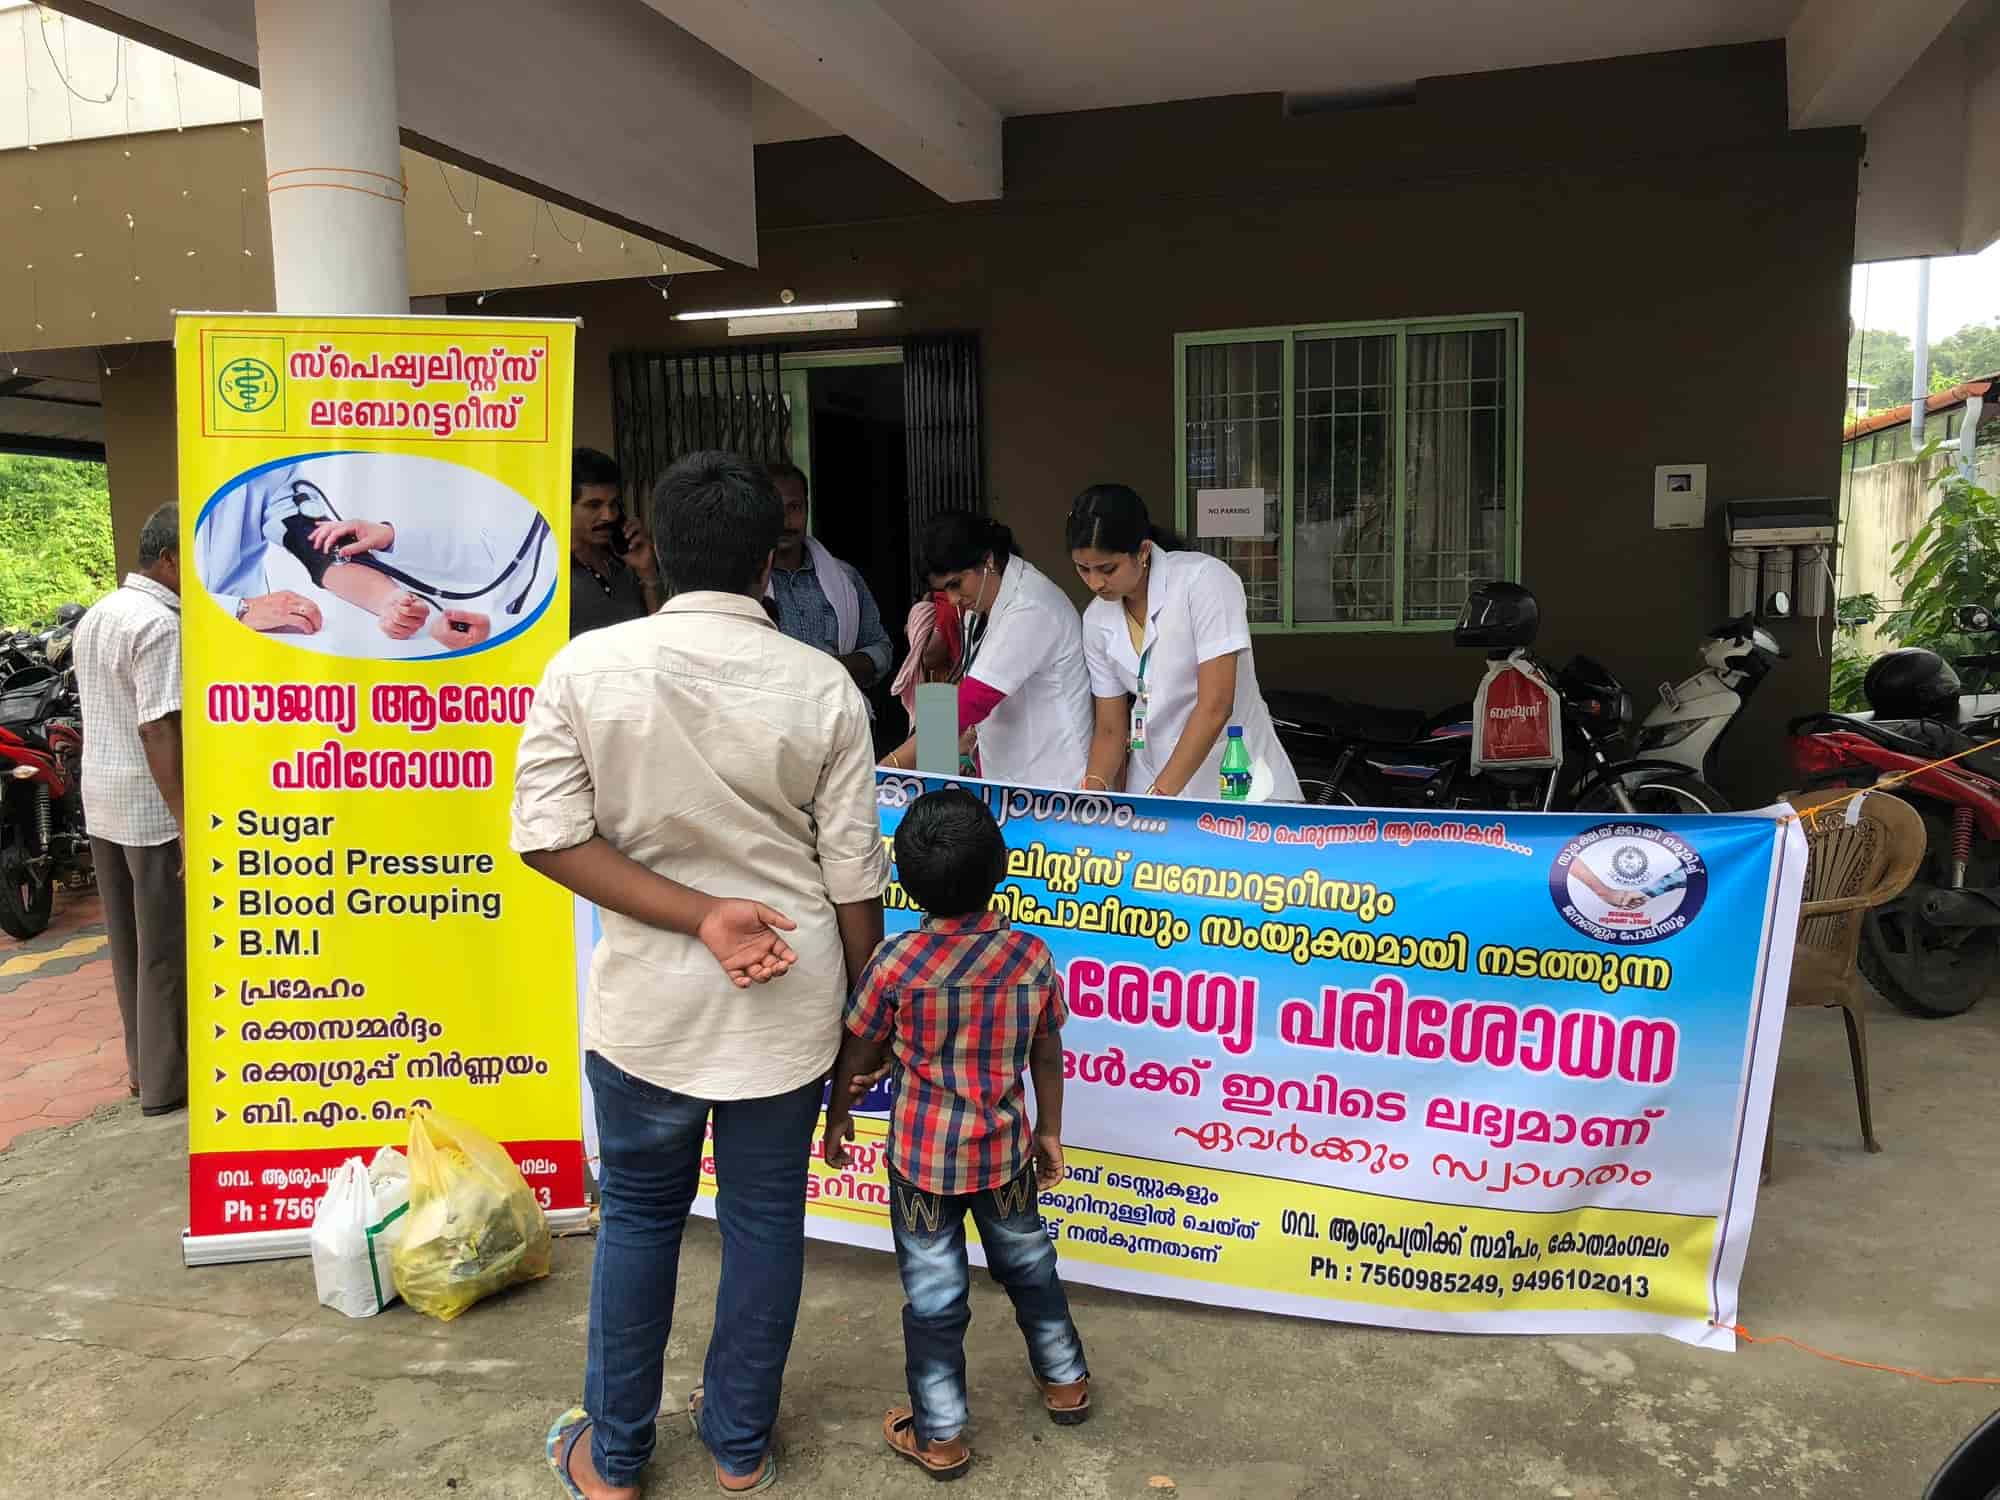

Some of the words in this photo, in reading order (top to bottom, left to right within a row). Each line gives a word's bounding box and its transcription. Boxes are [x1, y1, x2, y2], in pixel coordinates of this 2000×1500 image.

[310, 396, 524, 436] ലബോറട്ടറീസ്
[372, 684, 535, 731] ആരോഗ
[272, 741, 493, 789] പരിശോധന
[237, 809, 335, 842] Sugar
[1199, 813, 1245, 839] കന്നി
[1249, 822, 1271, 842] 20
[1275, 818, 1378, 848] പെരുന്നാൾ
[238, 849, 334, 876] Blood
[346, 848, 494, 876] Pressure
[238, 889, 335, 916] Blood
[346, 887, 502, 920] Grouping
[1132, 860, 1396, 922] ലബോറട്ടറീസും
[239, 929, 320, 956] B.M.I
[1201, 913, 1469, 970] സംയുക്തമായി
[1477, 941, 1673, 993] നടത്തുന്ന
[240, 979, 366, 1006] പ്രമേഹം
[1066, 959, 1256, 1054] രോഗ്യ
[1281, 977, 1679, 1085] പരിശോധന
[1222, 1072, 1407, 1122] ഇവിടെ
[1424, 1098, 1665, 1148] ലഭ്യമാണ്
[1174, 1121, 1409, 1175] ഏവർക്കും
[1431, 1153, 1652, 1193] സ്വാഗതം
[224, 1199, 253, 1223] Ph
[1182, 1213, 1260, 1241] ചെയ്ത്
[1547, 1231, 1670, 1259] കോതമംഗലം
[1310, 1256, 1338, 1281] Ph
[1511, 1268, 1650, 1298] 9496102013
